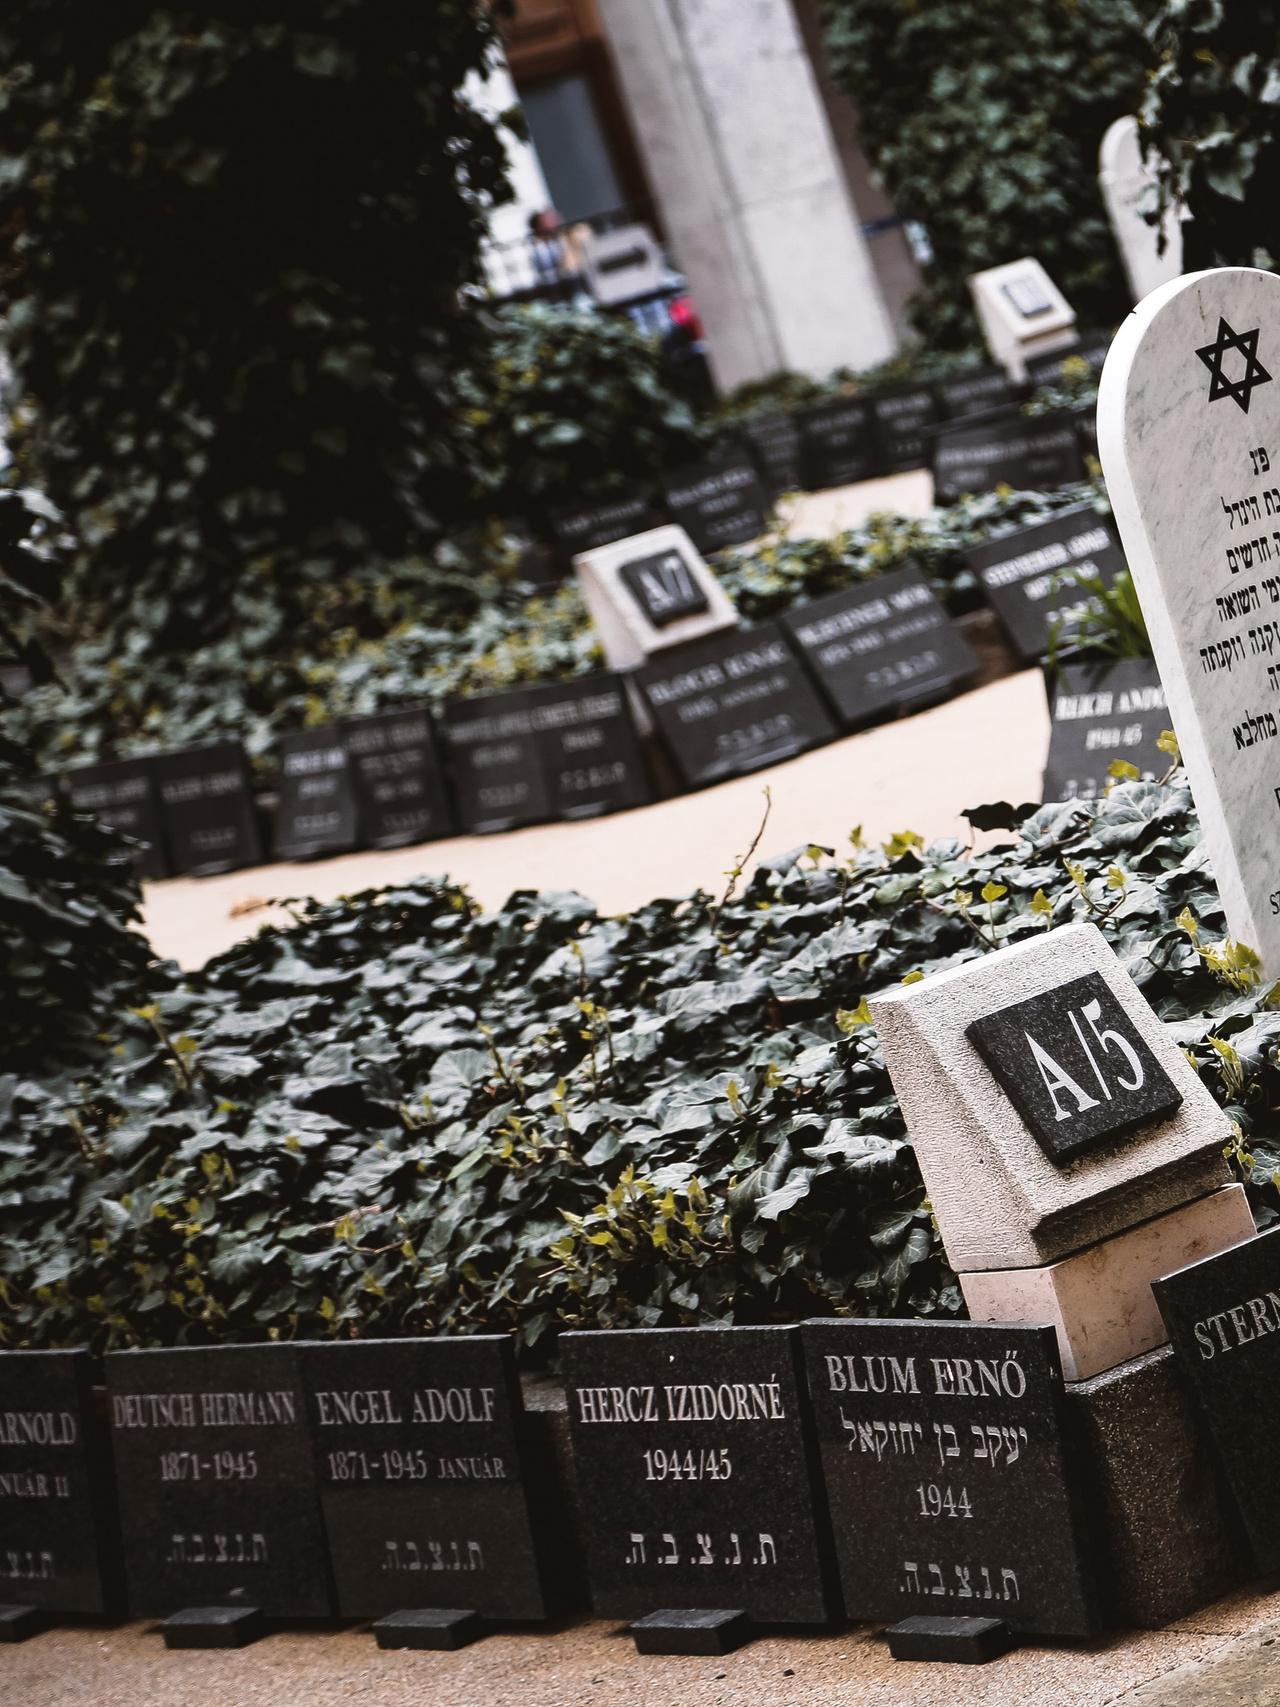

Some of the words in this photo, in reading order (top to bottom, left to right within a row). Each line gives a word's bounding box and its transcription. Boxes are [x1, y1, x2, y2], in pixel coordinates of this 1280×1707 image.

[1221, 496, 1261, 530] הינדל
[1226, 536, 1271, 574] חדשים
[1216, 585, 1261, 622] השואה
[1262, 576, 1280, 603] ימי
[1233, 710, 1277, 750] מחלבא
[1024, 998, 1144, 1122] A/5
[824, 1354, 921, 1395] BLUM
[930, 1350, 1028, 1399] ERNŐ
[112, 1394, 196, 1428] DEUTSCH
[200, 1391, 297, 1427] HERMANN
[315, 1390, 402, 1425] ENGEL
[412, 1388, 495, 1423] ADOLF
[576, 1385, 660, 1423] HERCZ
[663, 1373, 785, 1422] IZIDORNÉ
[933, 1422, 961, 1467] בן
[971, 1425, 1028, 1468] יעקב
[160, 1451, 258, 1481] 1871-1945
[328, 1450, 427, 1480] 1871-1945
[438, 1453, 506, 1479] JANUÁR
[643, 1448, 732, 1481] 1944/45
[916, 1483, 974, 1518] 1944
